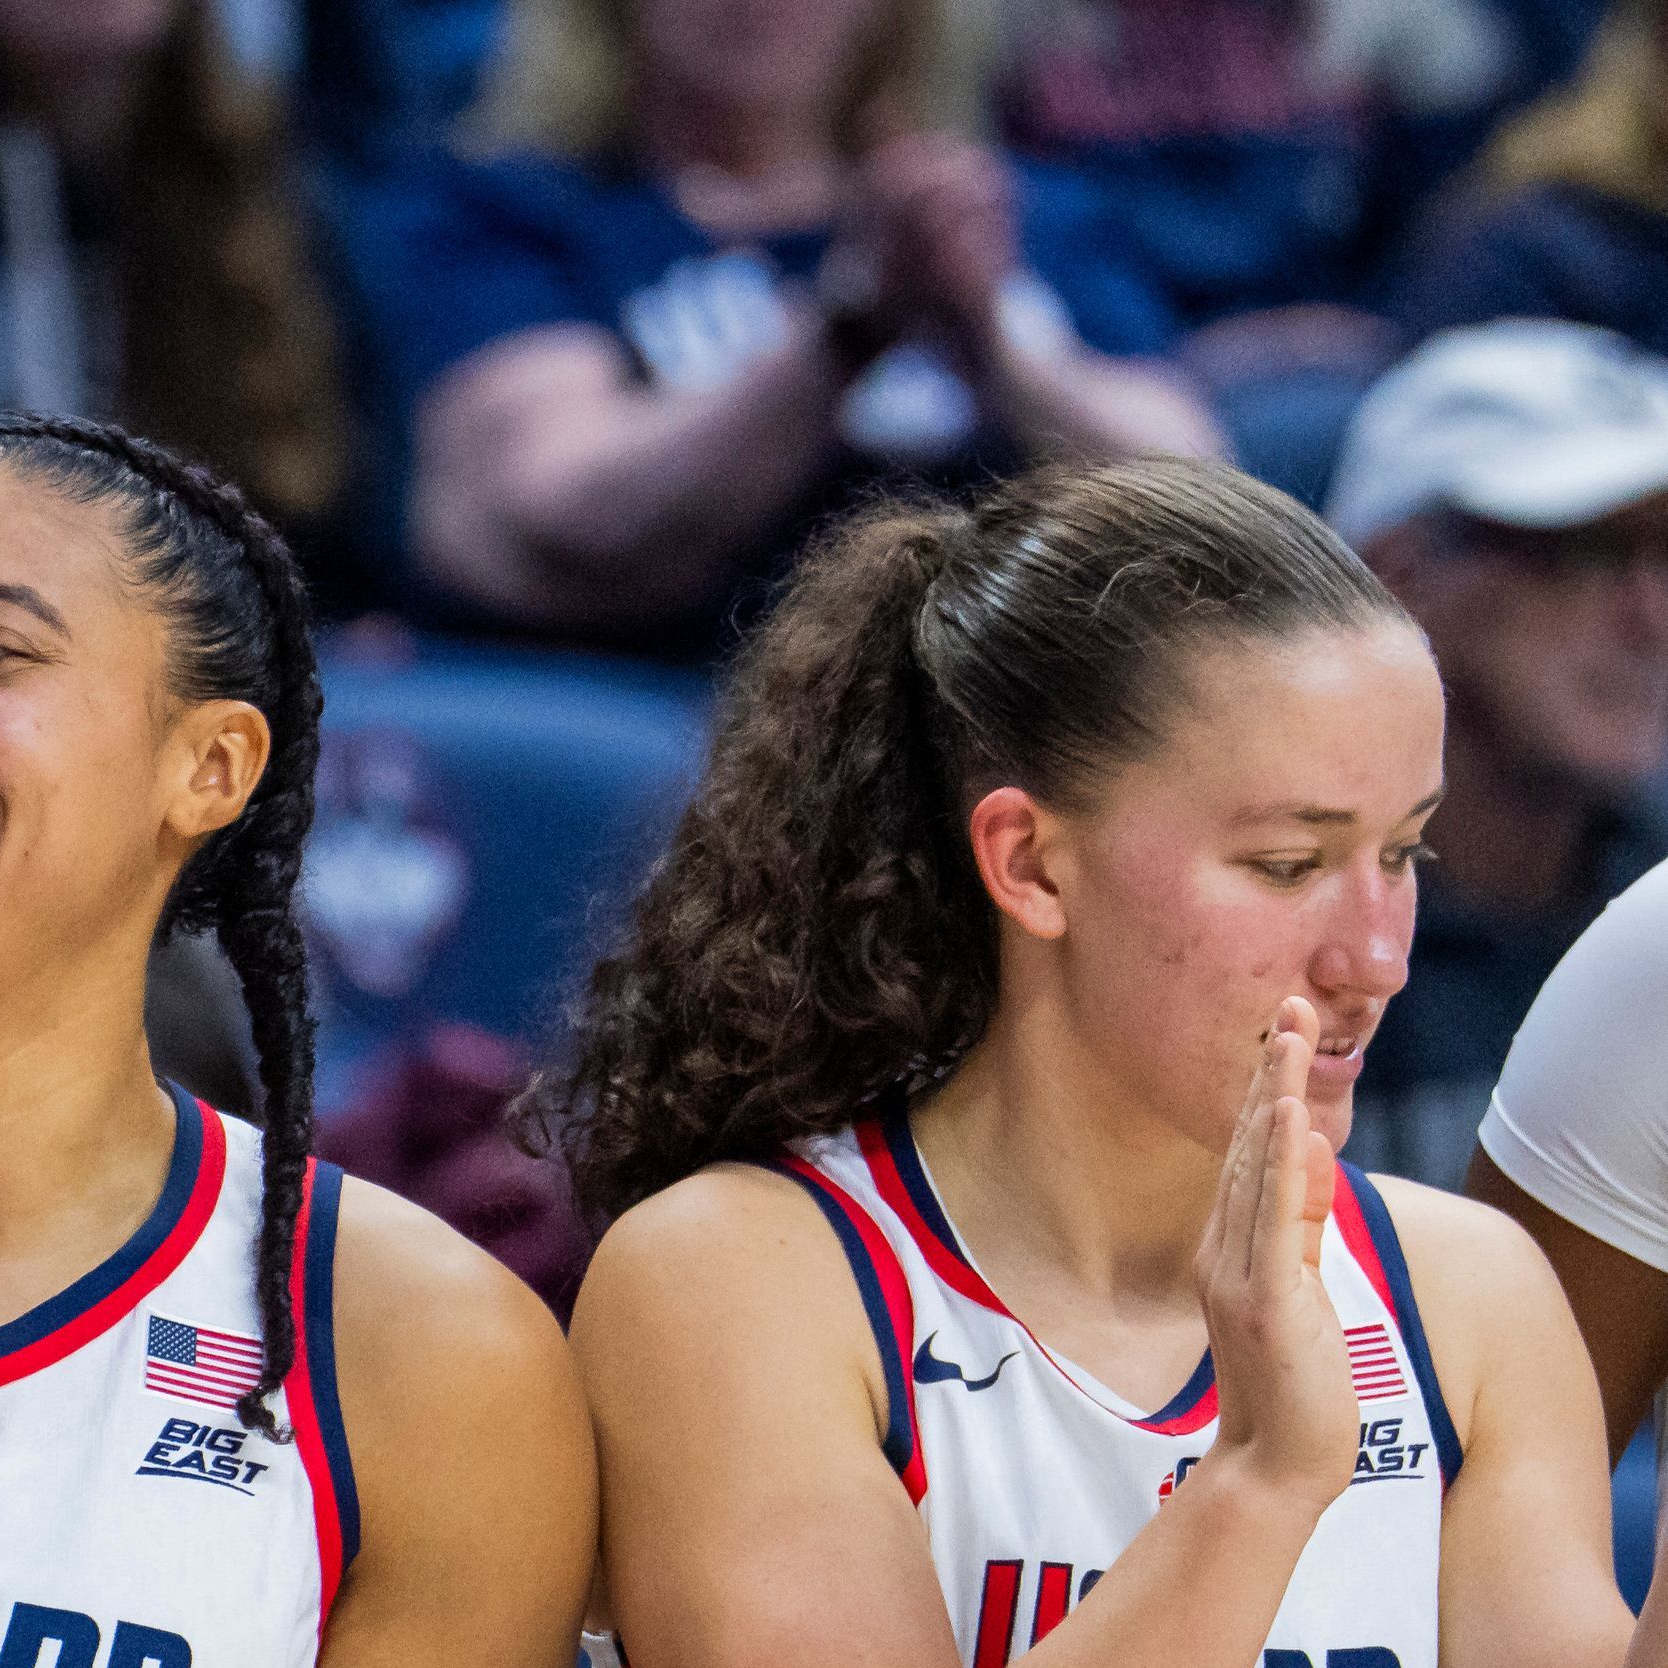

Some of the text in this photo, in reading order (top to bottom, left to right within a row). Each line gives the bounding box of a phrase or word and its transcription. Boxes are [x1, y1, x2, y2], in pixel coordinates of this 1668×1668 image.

[158, 1417, 248, 1455] BIG
[1359, 1418, 1403, 1448] IG
[143, 1441, 269, 1484] EAST
[1355, 1443, 1429, 1473] AST
